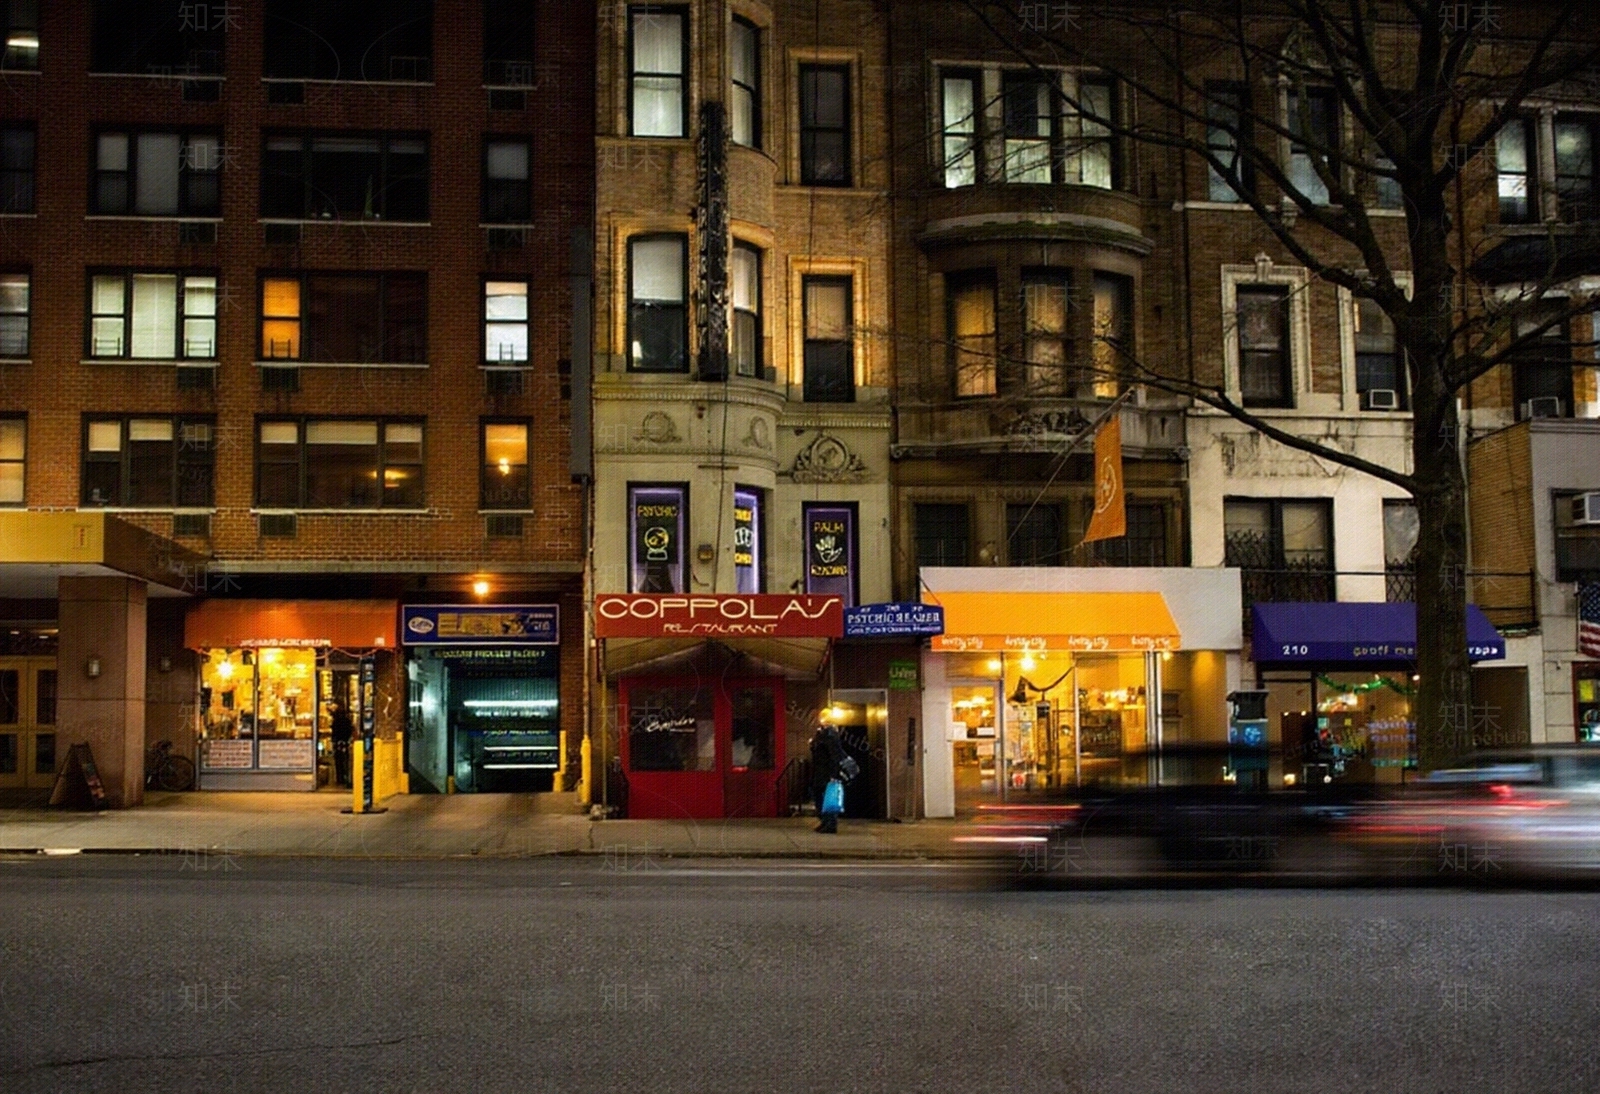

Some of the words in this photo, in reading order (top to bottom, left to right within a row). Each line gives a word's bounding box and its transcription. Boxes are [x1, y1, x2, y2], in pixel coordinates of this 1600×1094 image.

[814, 521, 844, 533] PALM
[599, 598, 840, 619] COPPOLA'S
[847, 612, 894, 624] PSYCHIC
[663, 623, 778, 633] RESTAURANT
[1282, 645, 1308, 655] 210
